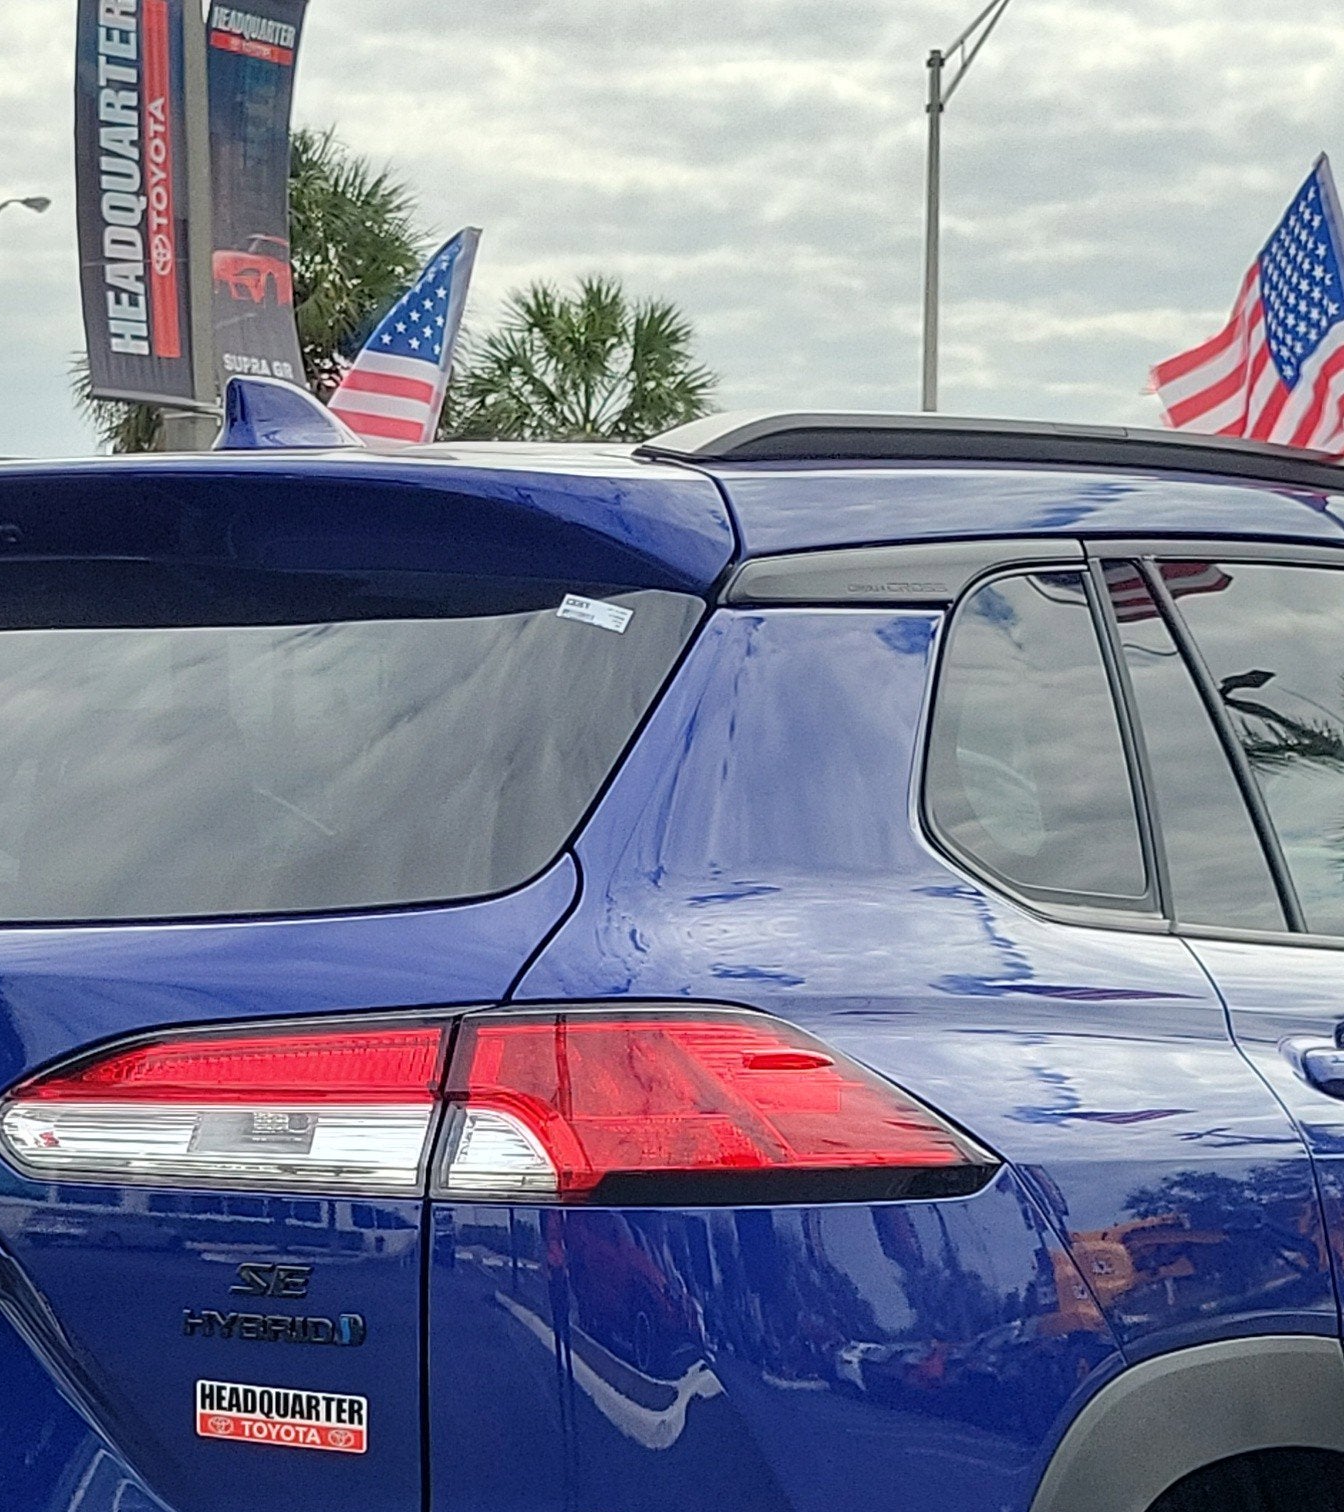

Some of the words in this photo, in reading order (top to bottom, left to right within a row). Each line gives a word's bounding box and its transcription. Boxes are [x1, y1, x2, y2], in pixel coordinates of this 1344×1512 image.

[212, 6, 296, 48] HEADQUARTER
[97, 0, 150, 356] HEADQUARTER
[147, 97, 169, 232] TOYOTA
[222, 352, 272, 376] SUPRA
[228, 1261, 314, 1298] SE
[182, 1308, 336, 1344] HYBRID
[200, 1382, 365, 1427] HEADQUARTER
[240, 1420, 322, 1445] TOYOTA
